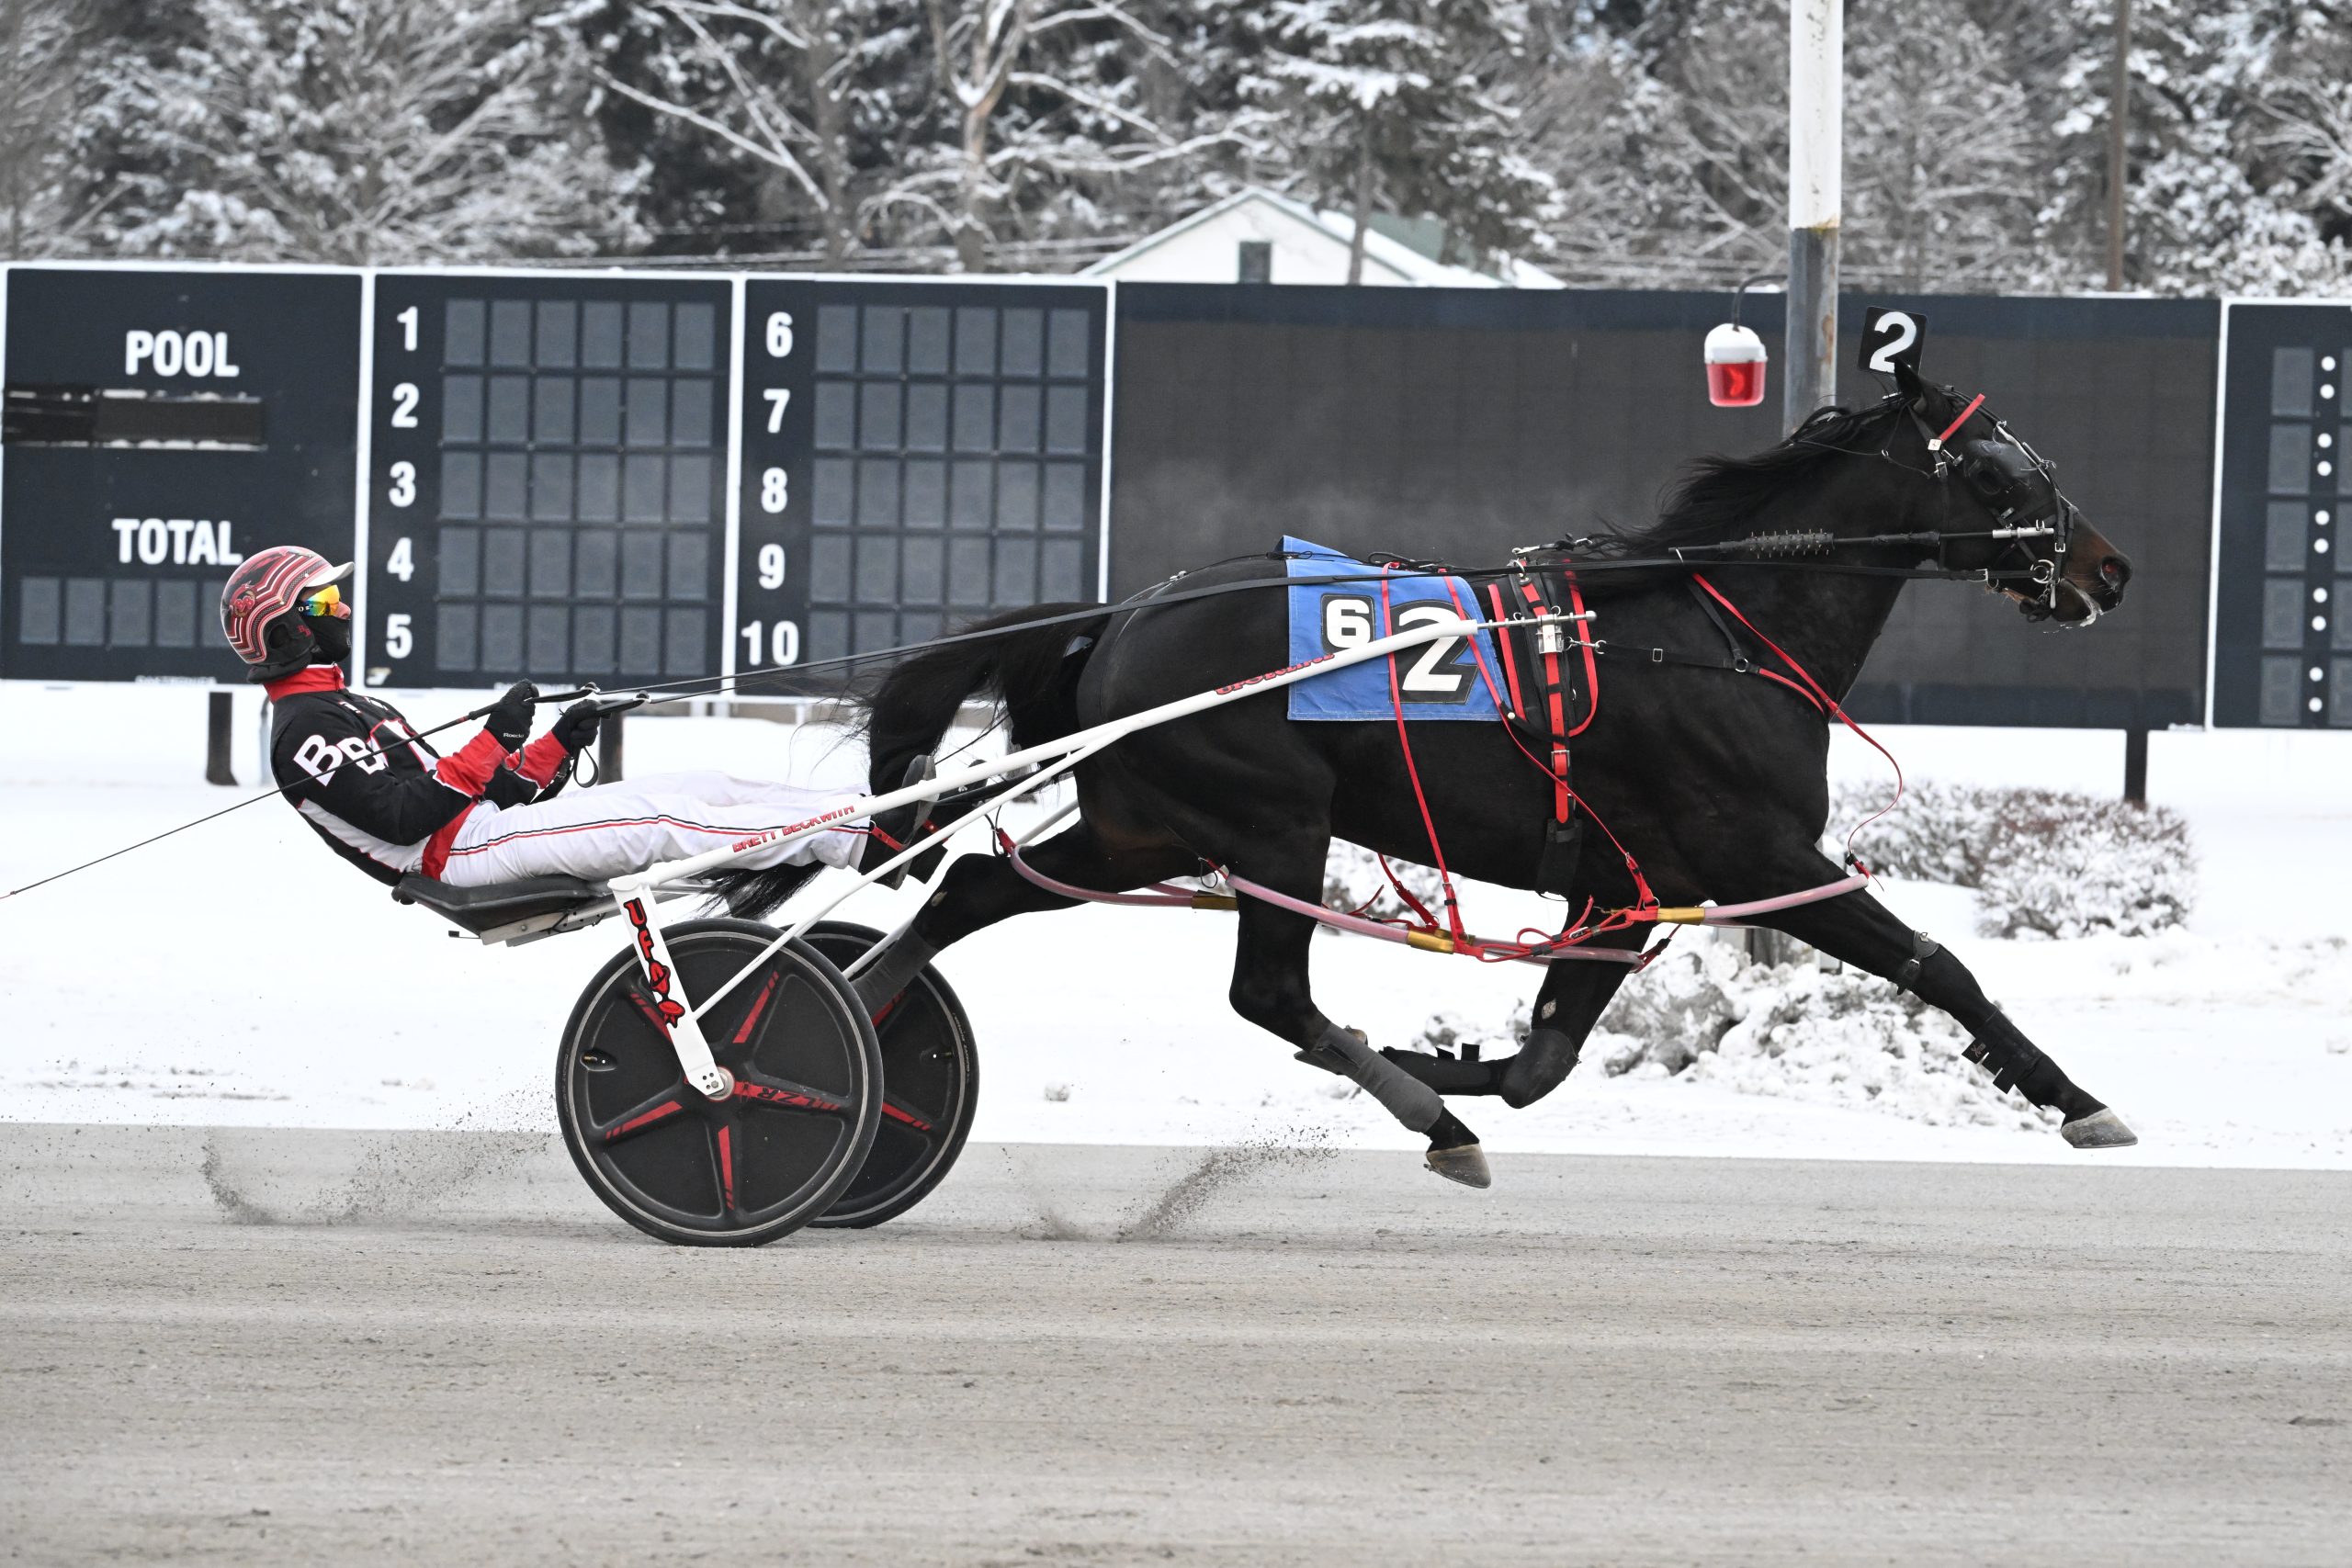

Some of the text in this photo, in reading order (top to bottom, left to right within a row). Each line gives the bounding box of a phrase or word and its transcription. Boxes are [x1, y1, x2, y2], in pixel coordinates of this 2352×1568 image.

[397, 306, 418, 352] 1
[766, 311, 793, 357] 6
[1869, 310, 1917, 374] 2
[125, 330, 240, 378] POOL
[391, 382, 420, 428] 2
[763, 389, 790, 434] 7
[389, 460, 416, 508] 3
[761, 467, 788, 513] 8
[111, 518, 243, 565] TOTAL
[387, 536, 414, 581] 4
[758, 543, 786, 590] 9
[386, 614, 413, 659] 5
[741, 620, 799, 666] 10
[1326, 599, 1372, 649] 6
[1398, 606, 1463, 692] 2
[731, 805, 855, 853] BRETT BECKWITH
